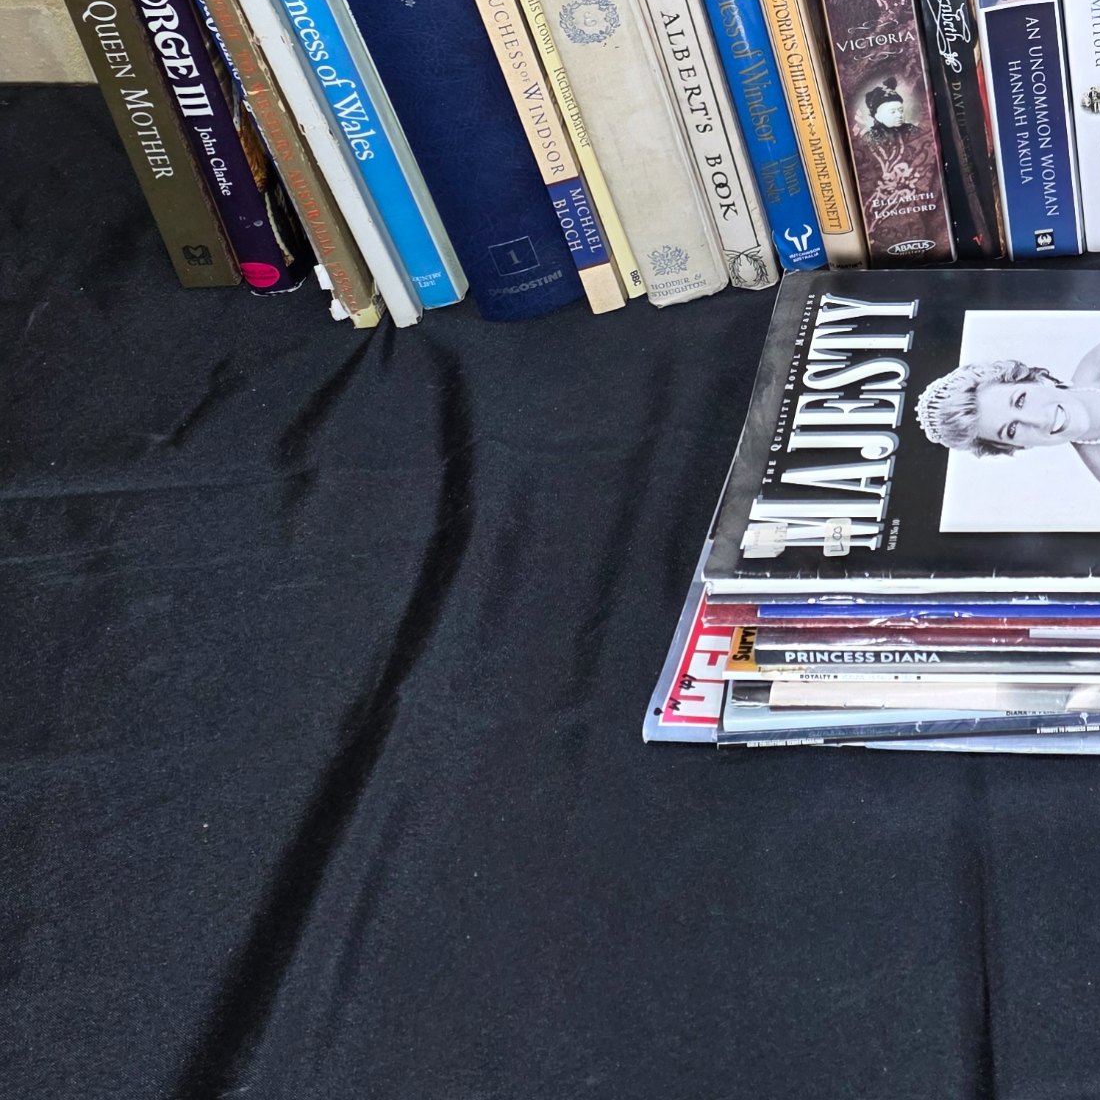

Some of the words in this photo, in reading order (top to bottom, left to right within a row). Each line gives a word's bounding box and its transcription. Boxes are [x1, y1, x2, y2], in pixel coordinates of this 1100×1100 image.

[534, 11, 555, 55] Crown
[731, 41, 763, 64] of
[836, 30, 916, 53] VICTORIA
[1025, 17, 1041, 40] AN
[82, 0, 136, 80] QUEEN
[120, 88, 174, 180] MOTHER
[316, 64, 356, 88] of
[739, 59, 779, 146] Windsor
[785, 53, 817, 122] CHILDREN
[1008, 60, 1028, 126] HANNAH
[1029, 45, 1051, 148] UNCOMMON
[332, 90, 376, 162] Wales
[522, 81, 565, 176] WINDSOR
[660, 11, 713, 135] ALBERT'S
[705, 153, 738, 221] BOOK
[950, 81, 967, 135] DAVID
[173, 83, 213, 119] III
[195, 126, 217, 156] John
[210, 156, 232, 196] Clarke
[808, 137, 831, 181] DAPHNE
[1016, 131, 1034, 185] PAKULA
[780, 152, 802, 196] Diana
[872, 192, 935, 207] ELIZABETH
[1040, 154, 1060, 216] WOMAN
[287, 169, 337, 256] AUSTRALIA
[552, 198, 583, 253] BLOCH
[570, 187, 602, 253] MICHAEL
[819, 181, 843, 230] BENNETT
[873, 203, 937, 219] LONGFORD
[507, 249, 521, 265] 1
[894, 241, 931, 252] ABACUS
[630, 269, 642, 287] BBC
[762, 459, 776, 484] THE
[770, 399, 790, 452] QUALITY
[784, 355, 801, 391] ROYAL
[794, 293, 816, 346] MAGAZINE
[740, 293, 919, 551] MAJESTY
[785, 651, 876, 663] PRINCESS
[880, 651, 941, 664] DIANA
